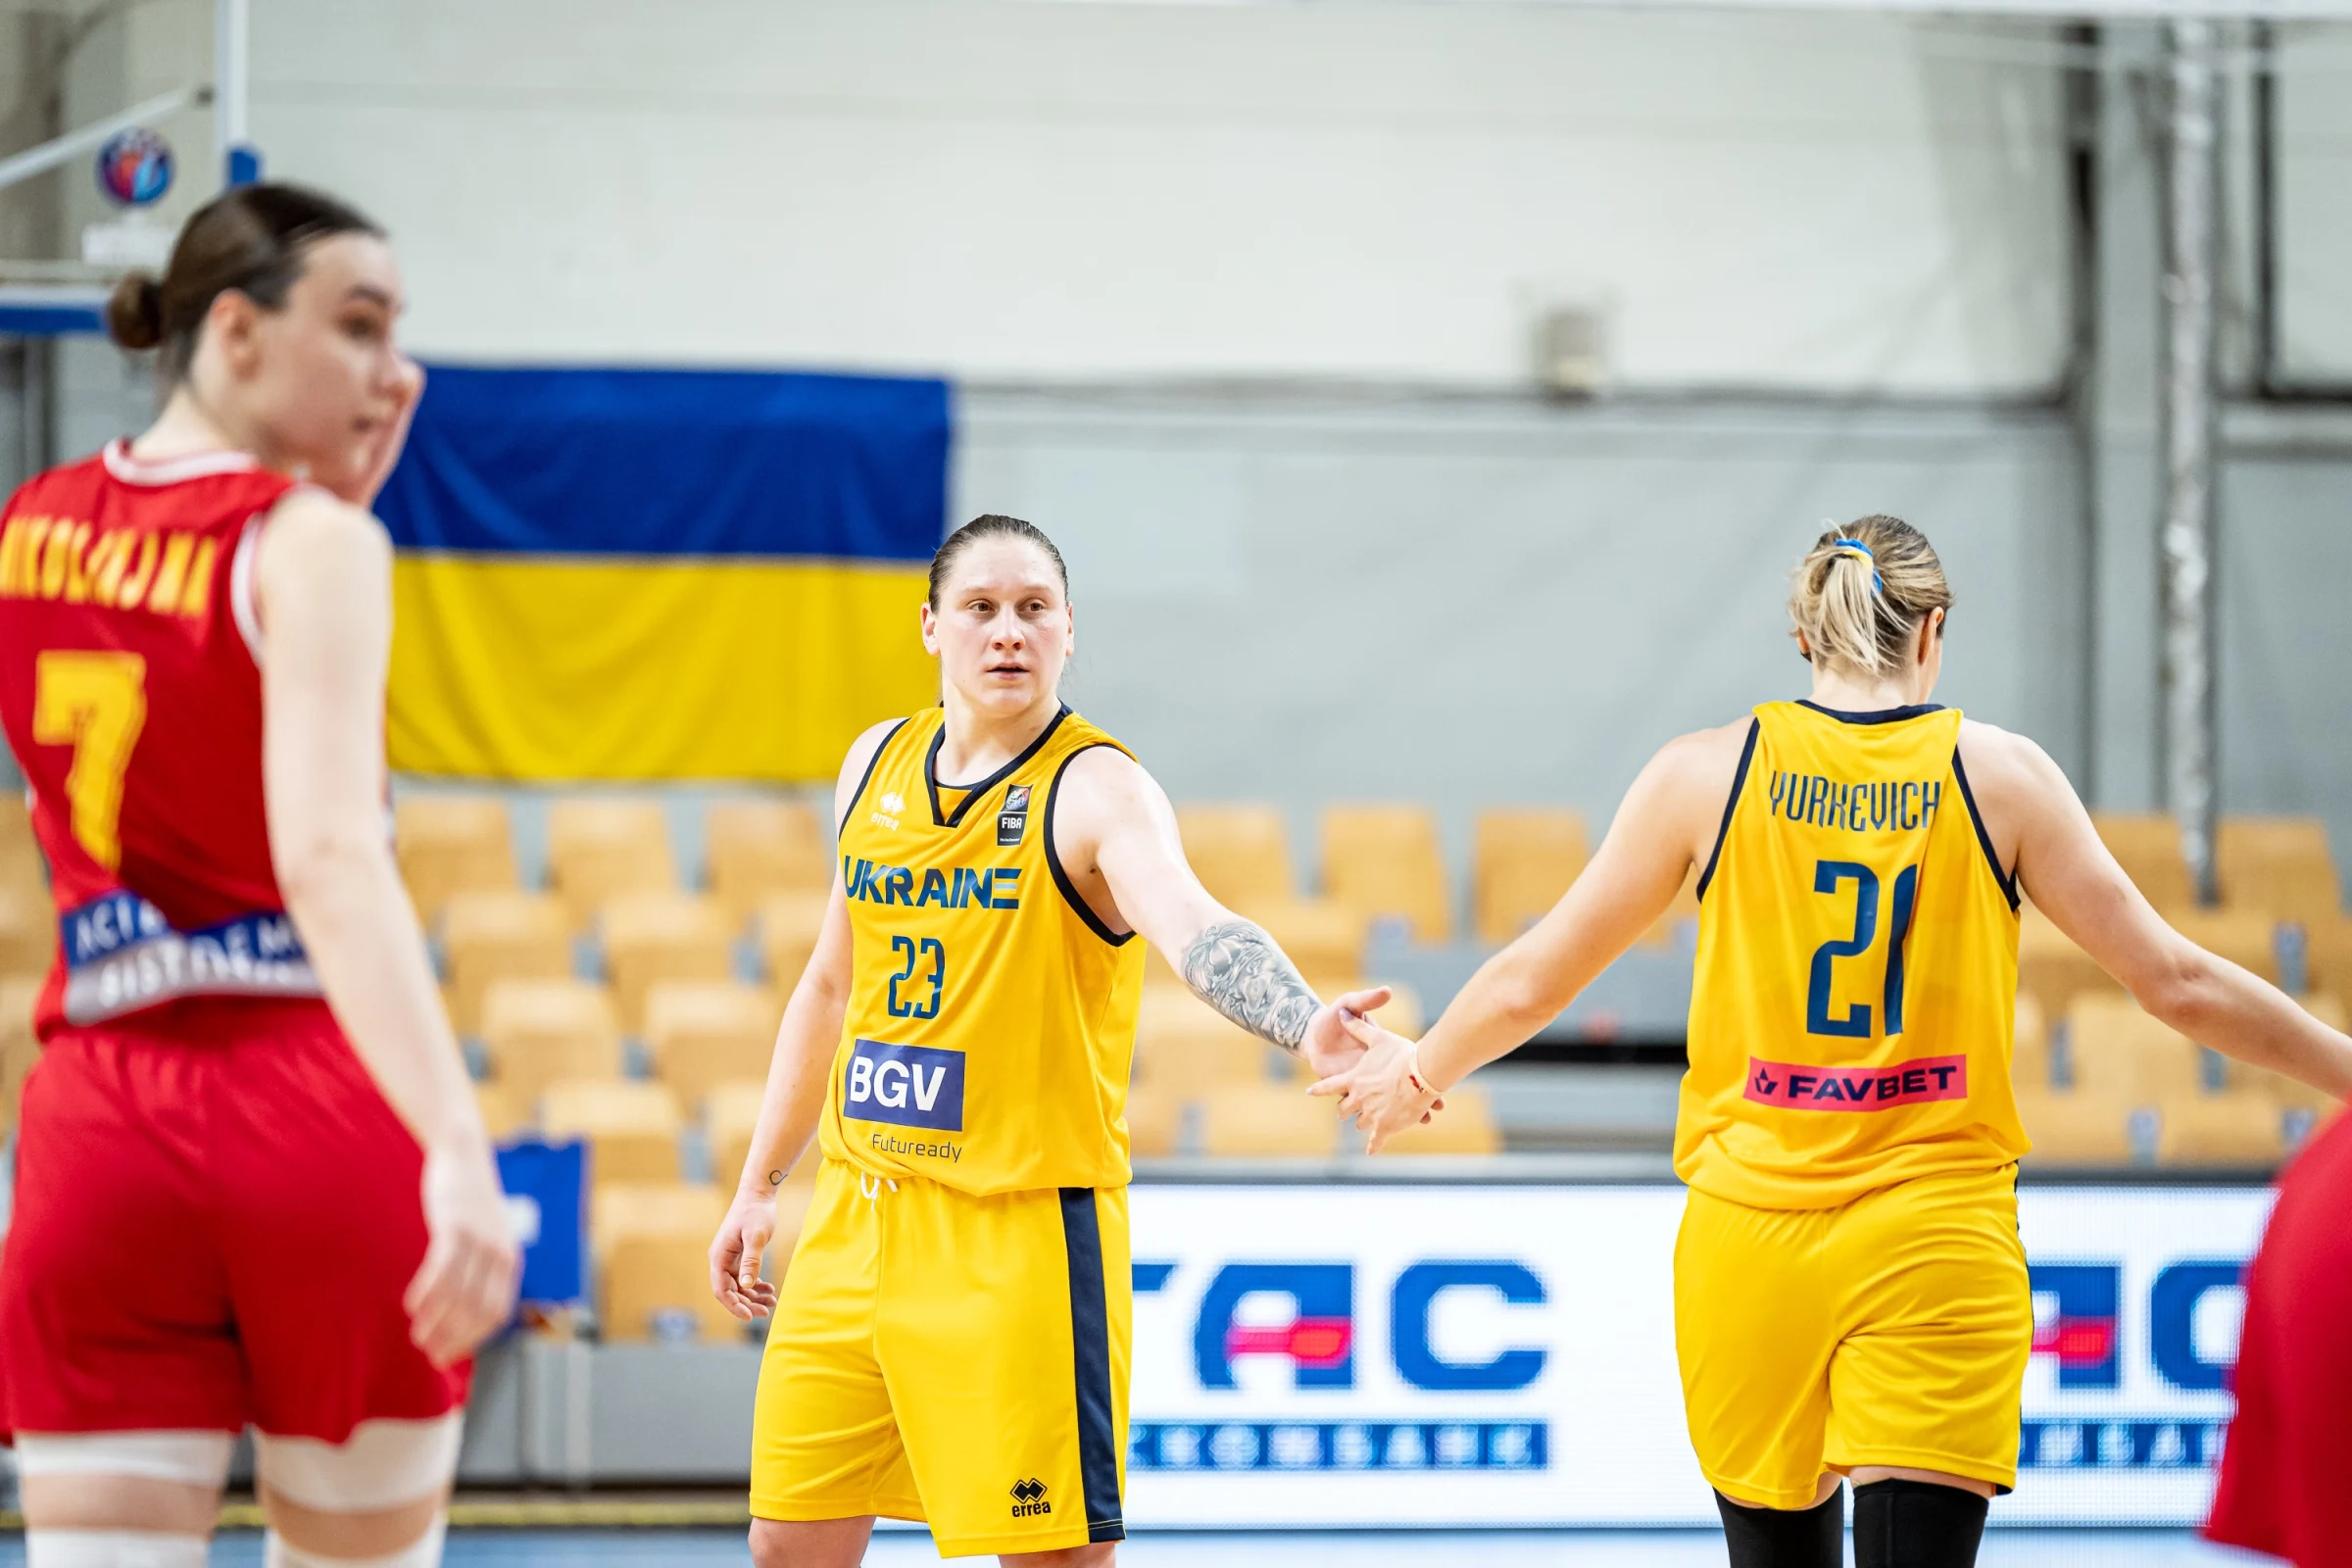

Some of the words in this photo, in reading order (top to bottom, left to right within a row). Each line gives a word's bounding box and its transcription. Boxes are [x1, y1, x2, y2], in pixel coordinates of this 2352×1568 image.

[33, 648, 148, 875] 7
[1002, 816, 1022, 829] FIBA
[1769, 770, 1940, 832] YURKEVICH
[844, 855, 1023, 909] UKRAINE
[1806, 858, 1918, 1038] 21
[888, 935, 946, 1019] 23
[850, 1054, 947, 1111] BGV
[1788, 1065, 1957, 1102] FAVBET
[871, 1133, 963, 1163] Futuready
